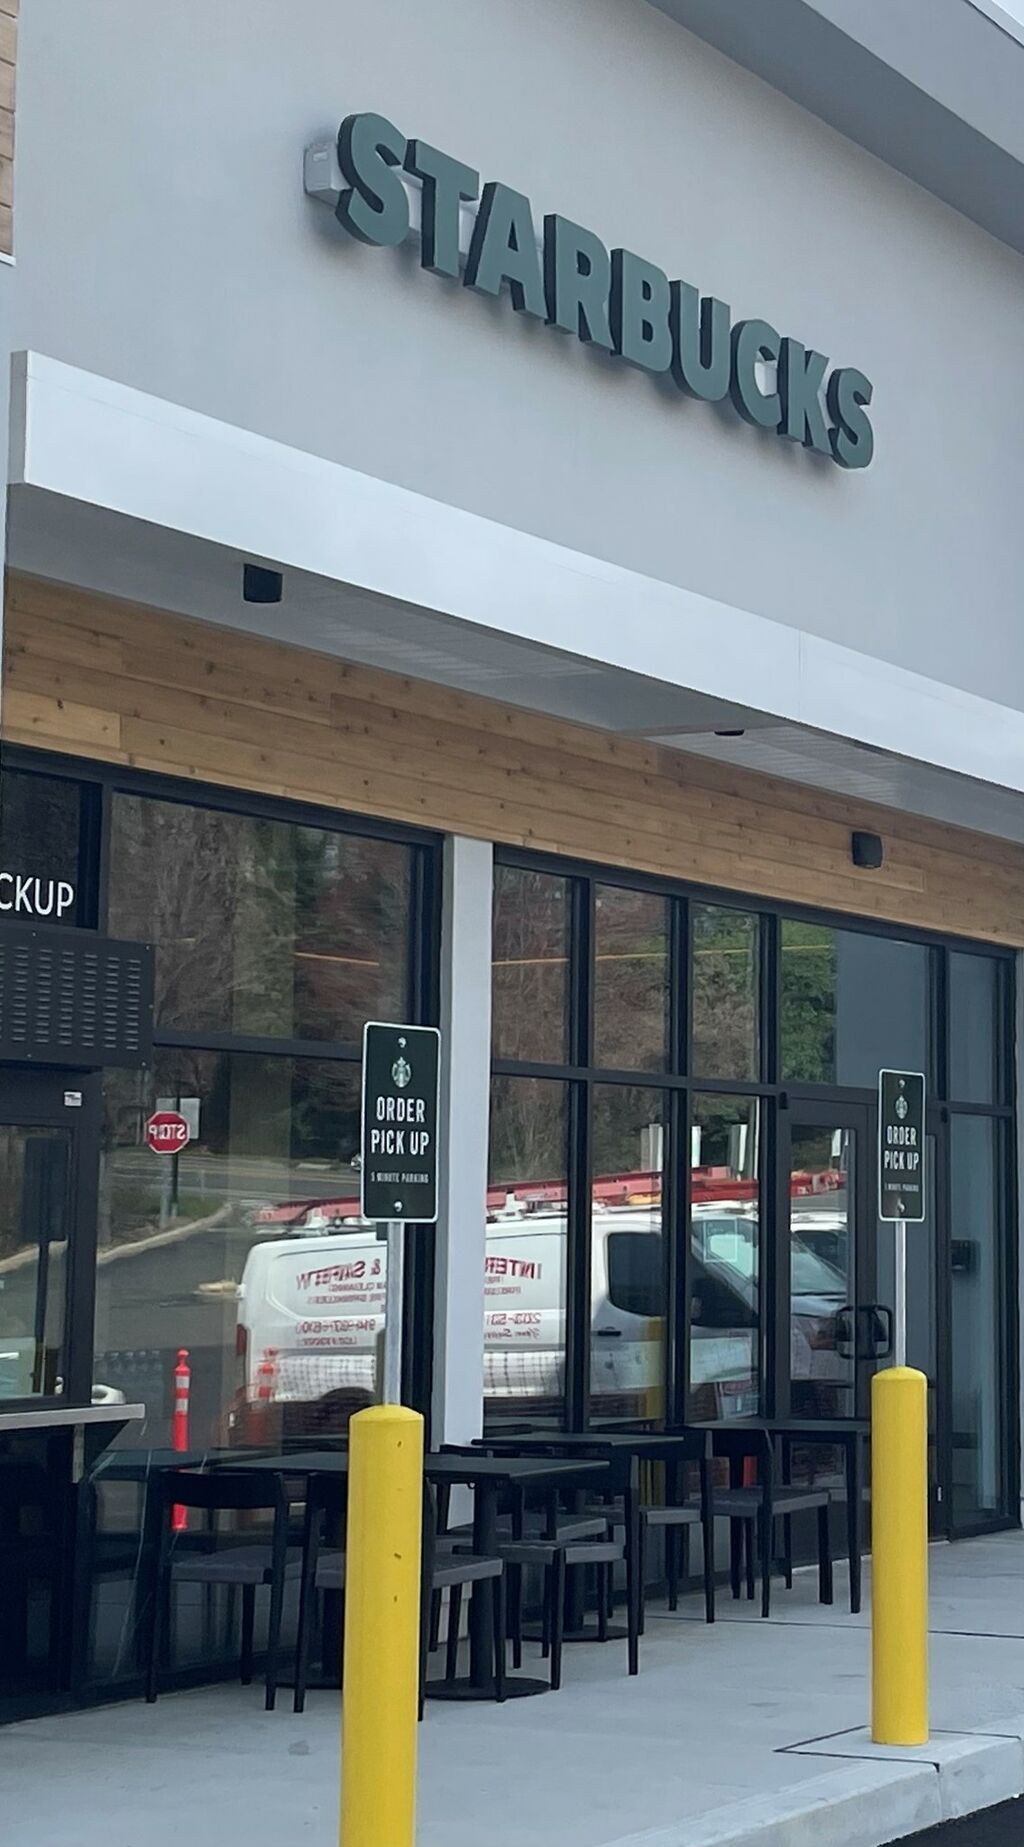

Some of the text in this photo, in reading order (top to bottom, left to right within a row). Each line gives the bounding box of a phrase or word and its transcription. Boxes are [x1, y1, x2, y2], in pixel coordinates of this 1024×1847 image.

[335, 111, 874, 469] STARBUCKS
[376, 1096, 425, 1123] ORDER
[370, 1128, 430, 1156] PICK UP
[886, 1125, 917, 1146] ORDER
[884, 1150, 919, 1170] PICK UP
